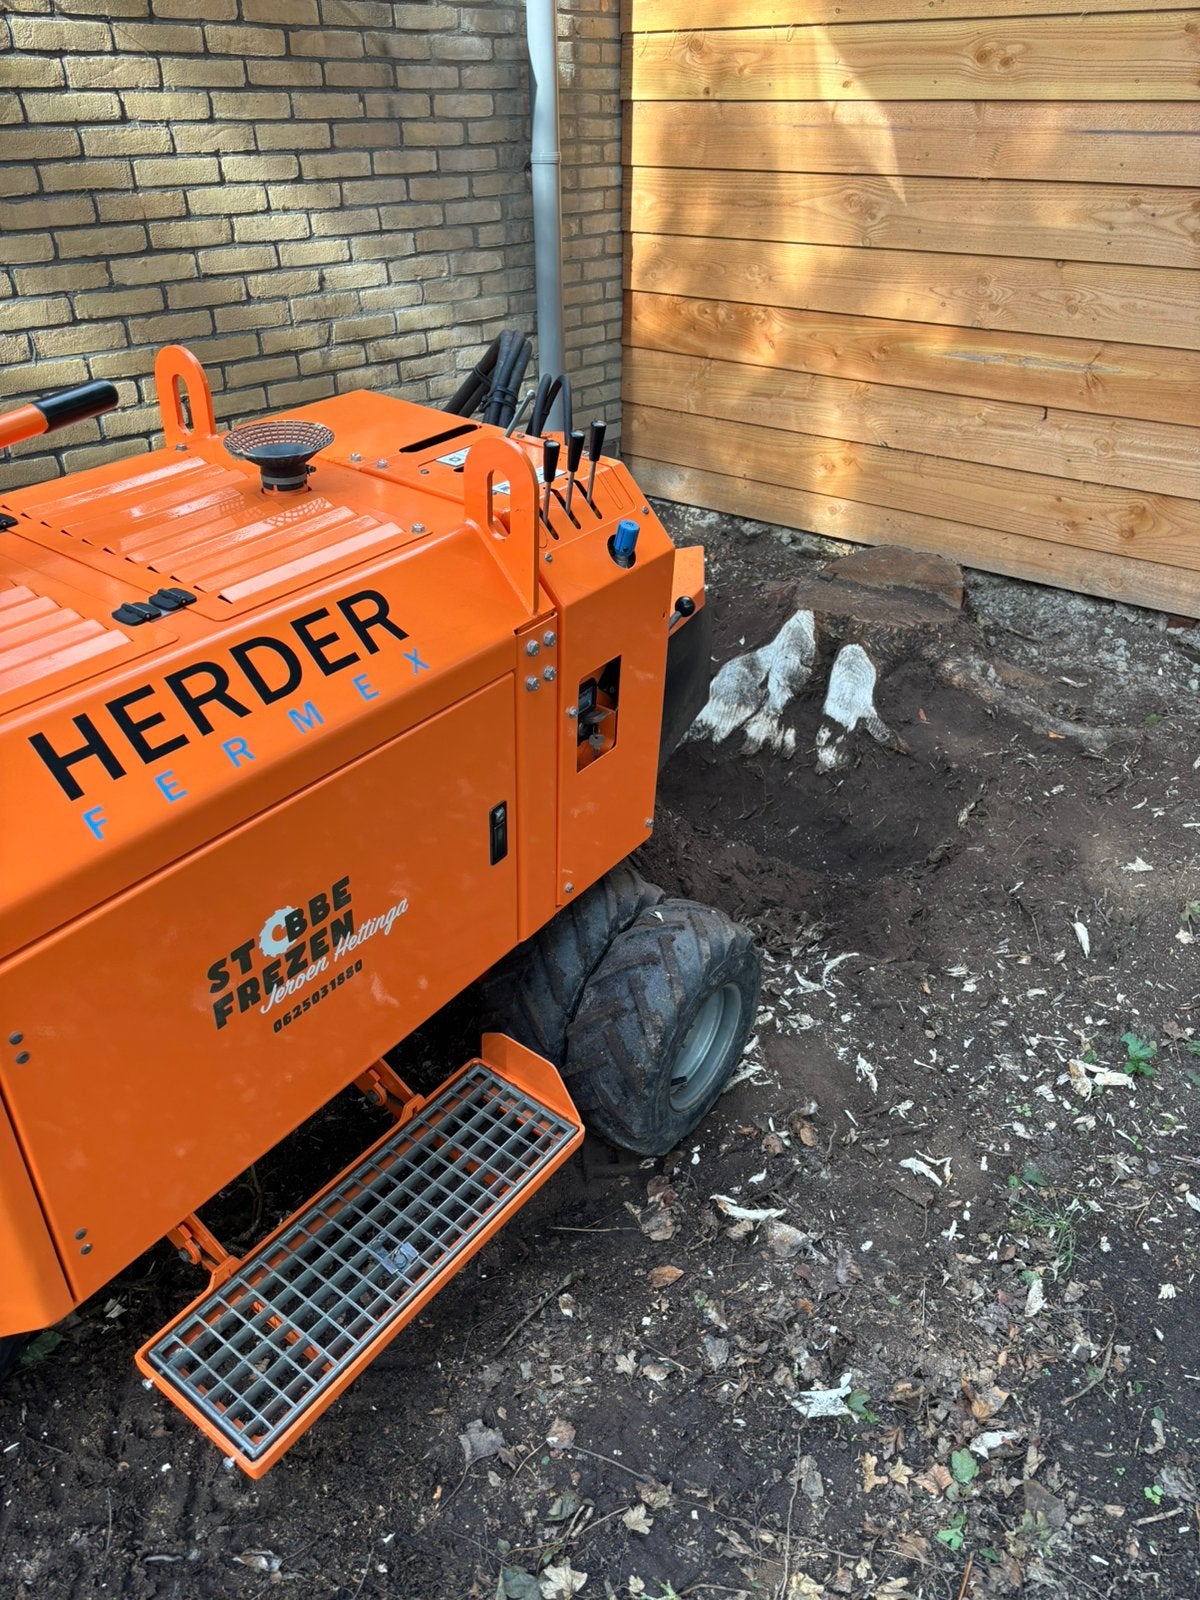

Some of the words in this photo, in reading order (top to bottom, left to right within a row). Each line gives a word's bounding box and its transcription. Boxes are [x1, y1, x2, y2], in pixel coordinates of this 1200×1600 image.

[28, 589, 410, 801] HERDER
[82, 648, 430, 840] FERMEX
[212, 908, 355, 1030] FREZEN
[260, 955, 330, 1015] Jeroen
[333, 898, 409, 962] Hettinga
